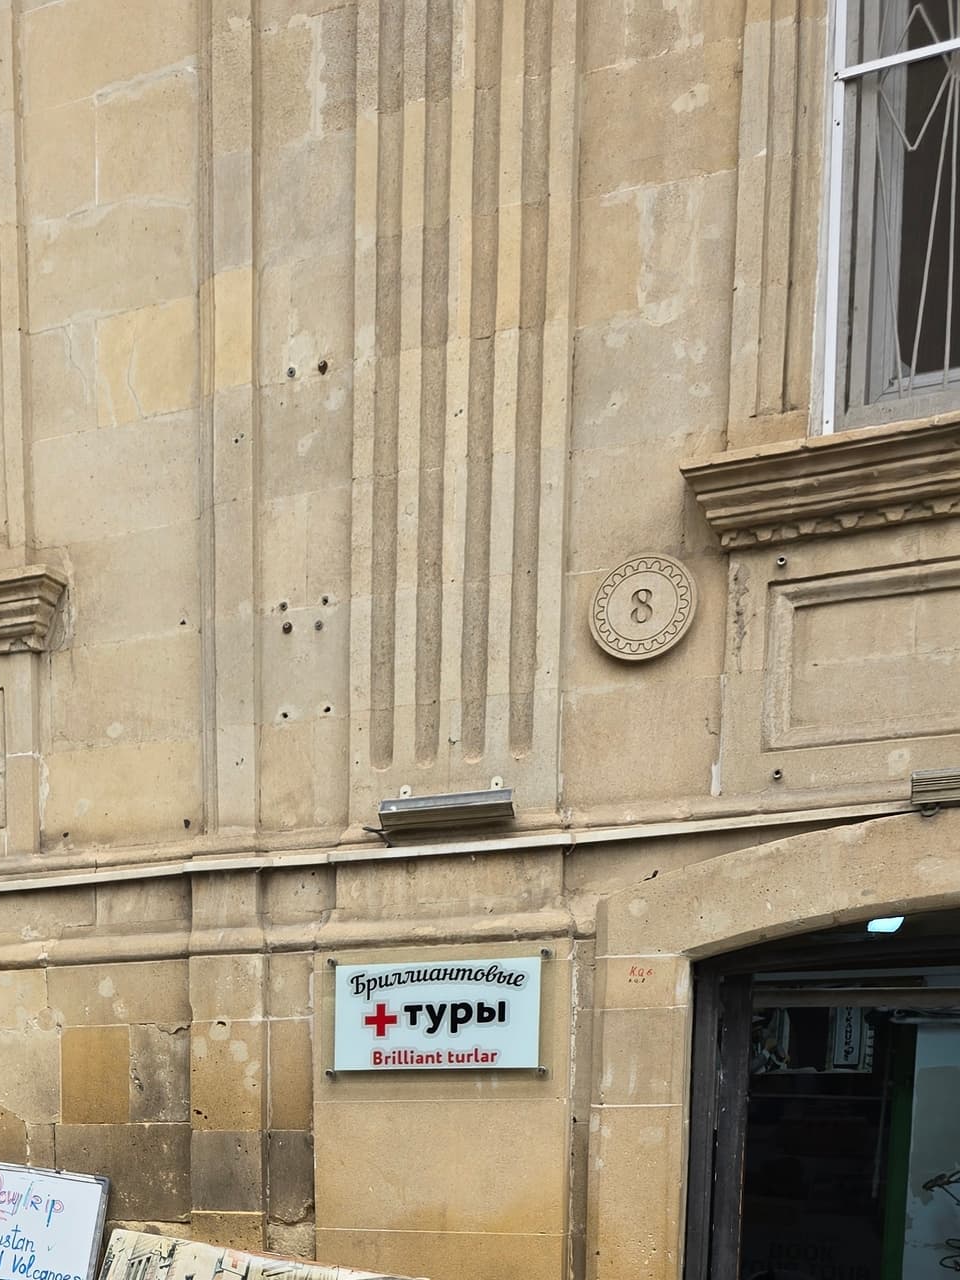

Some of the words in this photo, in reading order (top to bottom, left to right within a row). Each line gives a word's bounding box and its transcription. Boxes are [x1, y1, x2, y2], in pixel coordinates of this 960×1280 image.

[630, 588, 653, 624] 8
[351, 965, 525, 1000] Бриллиантовые
[404, 1000, 506, 1034] туры
[373, 1051, 443, 1066] Brilliant
[447, 1048, 498, 1064] turlar
